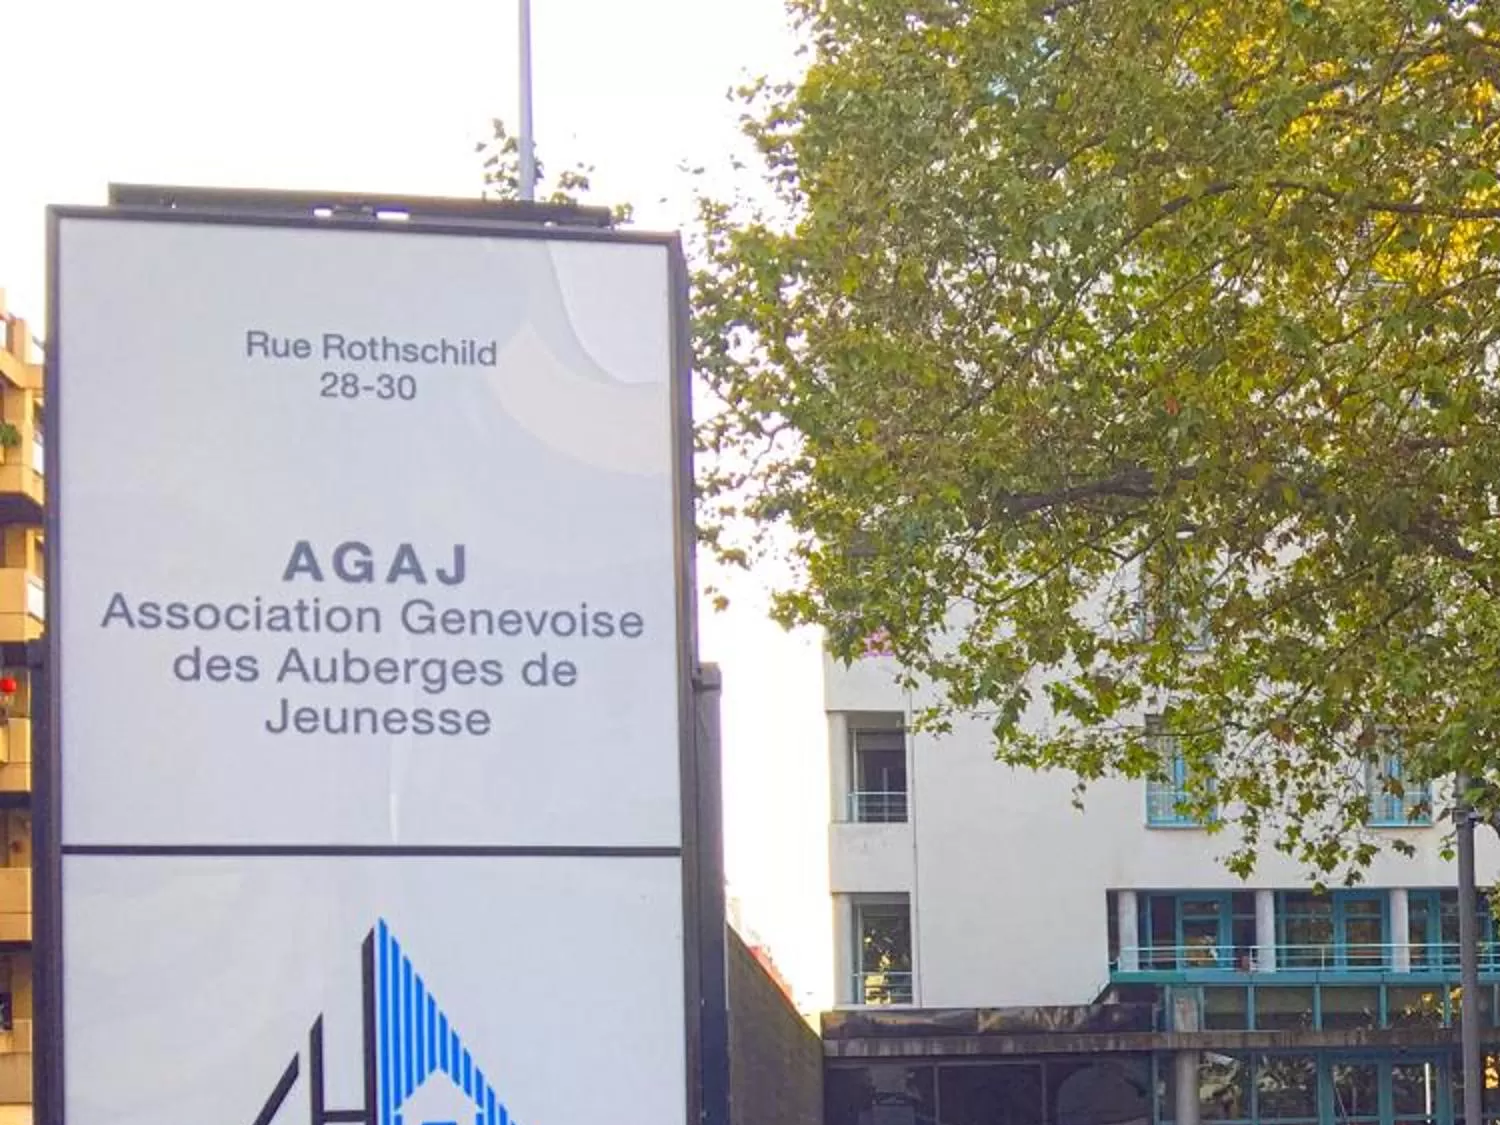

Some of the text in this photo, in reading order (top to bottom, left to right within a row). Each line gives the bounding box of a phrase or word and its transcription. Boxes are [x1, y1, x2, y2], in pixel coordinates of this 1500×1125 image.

[247, 330, 497, 366] Rue Rothschild
[320, 371, 417, 401] 28-30
[282, 540, 466, 586] AGAJ
[100, 592, 644, 639] Association Genevoise
[173, 645, 578, 695] des Auberges de
[265, 698, 491, 736] Jeunesse
